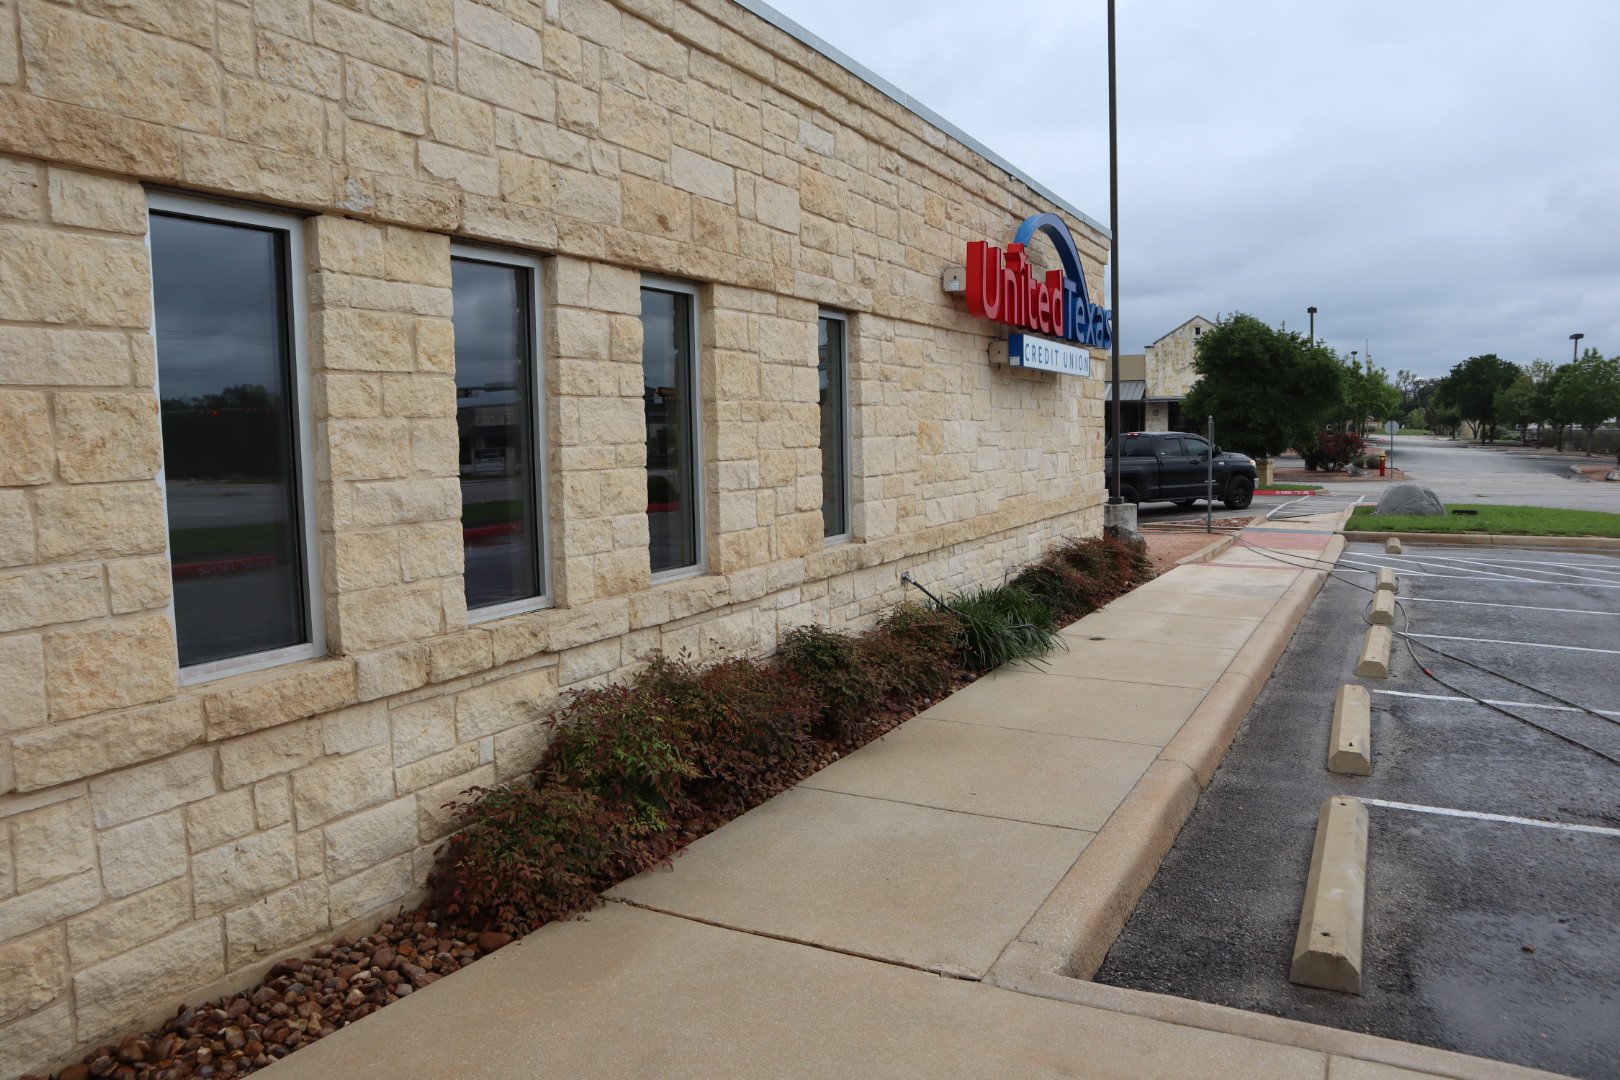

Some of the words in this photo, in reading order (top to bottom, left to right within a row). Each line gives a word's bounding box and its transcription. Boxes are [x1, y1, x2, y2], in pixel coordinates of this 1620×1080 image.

[979, 240, 1064, 336] United
[1024, 343, 1059, 366] CREDIT
[1063, 351, 1089, 372] UNION
